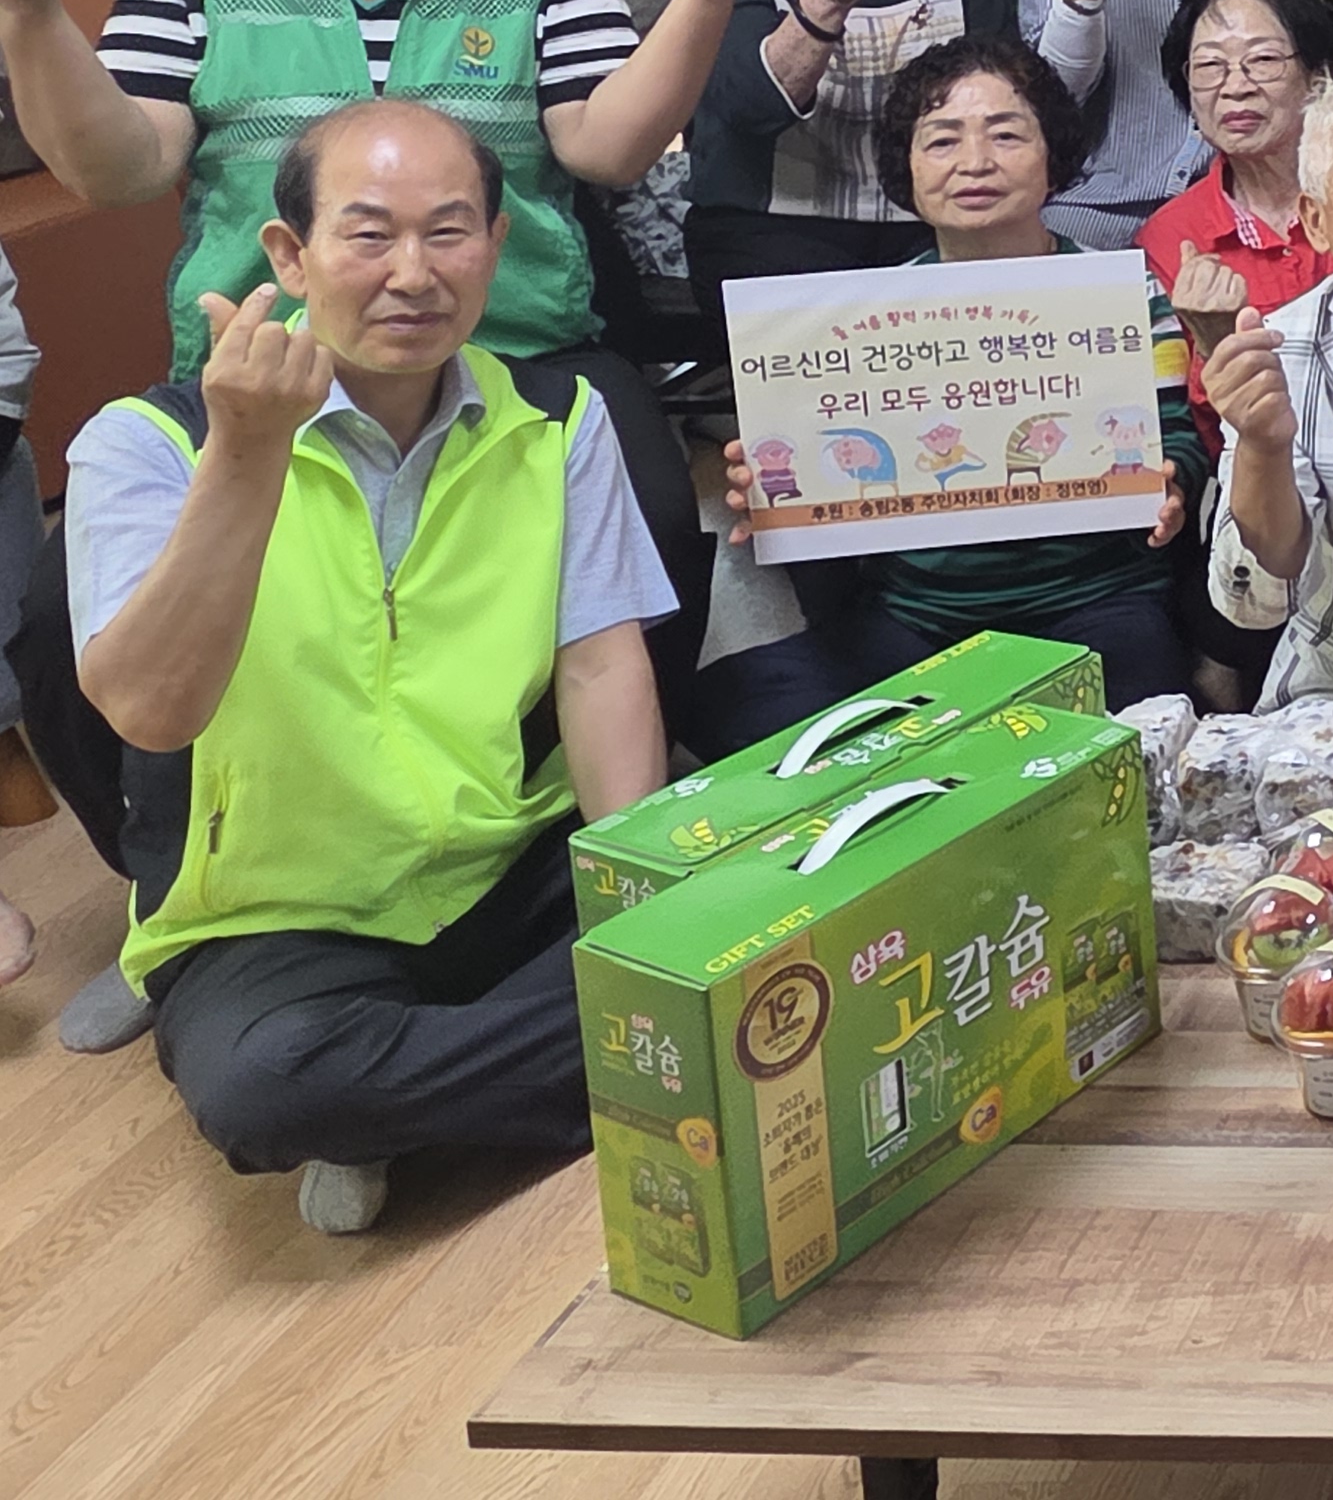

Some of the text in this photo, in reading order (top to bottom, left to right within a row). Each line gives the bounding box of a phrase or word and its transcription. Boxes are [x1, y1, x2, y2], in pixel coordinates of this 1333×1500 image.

[741, 325, 1143, 382] 어르신의 건강하고 행복한 여름을
[817, 373, 1081, 419] 우리 모두 응원합니다!
[811, 502, 844, 521] 후원
[921, 489, 999, 512] 주민자치회
[1004, 484, 1042, 503] (회장
[704, 905, 818, 976] GIFT SET
[851, 930, 906, 985] 삼육
[872, 894, 1051, 1054] 고칼슘
[1010, 965, 1052, 1010] 두유
[600, 1010, 683, 1077] 고칼슘
[686, 1127, 709, 1151] Ca
[970, 1103, 998, 1133] Ca
